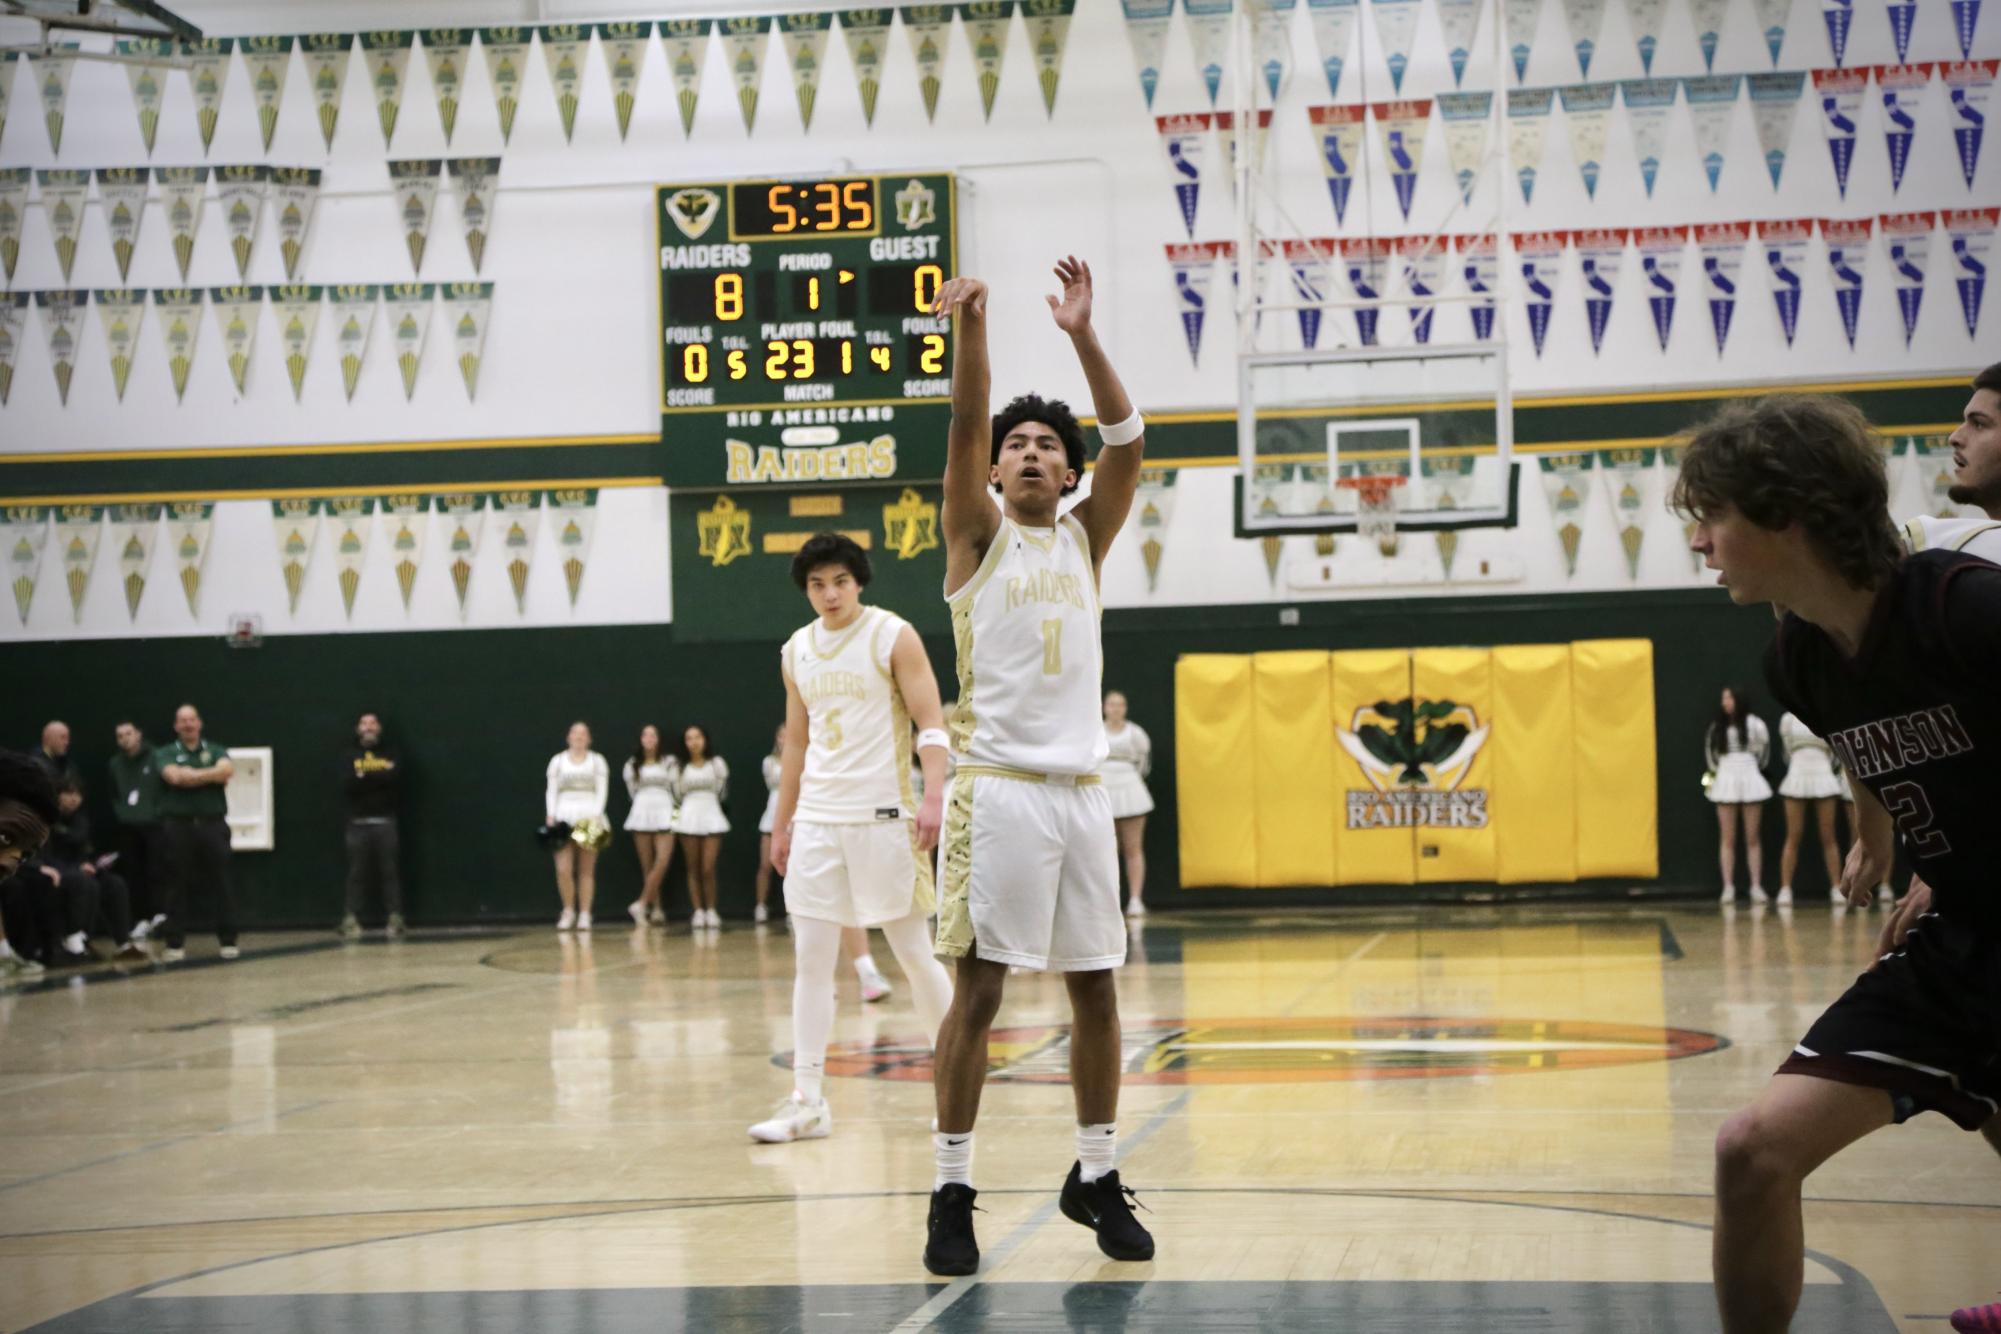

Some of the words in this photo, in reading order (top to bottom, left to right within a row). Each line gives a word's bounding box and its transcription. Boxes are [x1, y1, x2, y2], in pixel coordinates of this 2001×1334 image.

[769, 182, 872, 232] 5:35
[661, 243, 751, 269] RAIDERS
[779, 253, 832, 271] PERIOD
[870, 235, 940, 261] GUEST
[714, 273, 743, 321] 8
[809, 277, 819, 310] 1
[914, 265, 943, 313] 0
[666, 326, 712, 343] FOULS
[761, 322, 815, 340] PLAYER
[902, 317, 950, 335] FOULS
[684, 344, 708, 383] 0
[727, 350, 747, 380] 5
[765, 340, 815, 379] 23
[841, 341, 852, 374] 1
[870, 347, 890, 371] 4
[921, 335, 944, 373] 2
[667, 388, 714, 406] SCORE
[784, 383, 834, 401] MATCH
[903, 380, 951, 397] SCORE
[727, 411, 762, 427] RIO
[771, 406, 894, 426] AMERICANO
[725, 434, 897, 484] RAIDERS
[824, 708, 843, 751] 5
[1347, 802, 1489, 829] RAIDERS
[1880, 780, 1951, 859] 2
